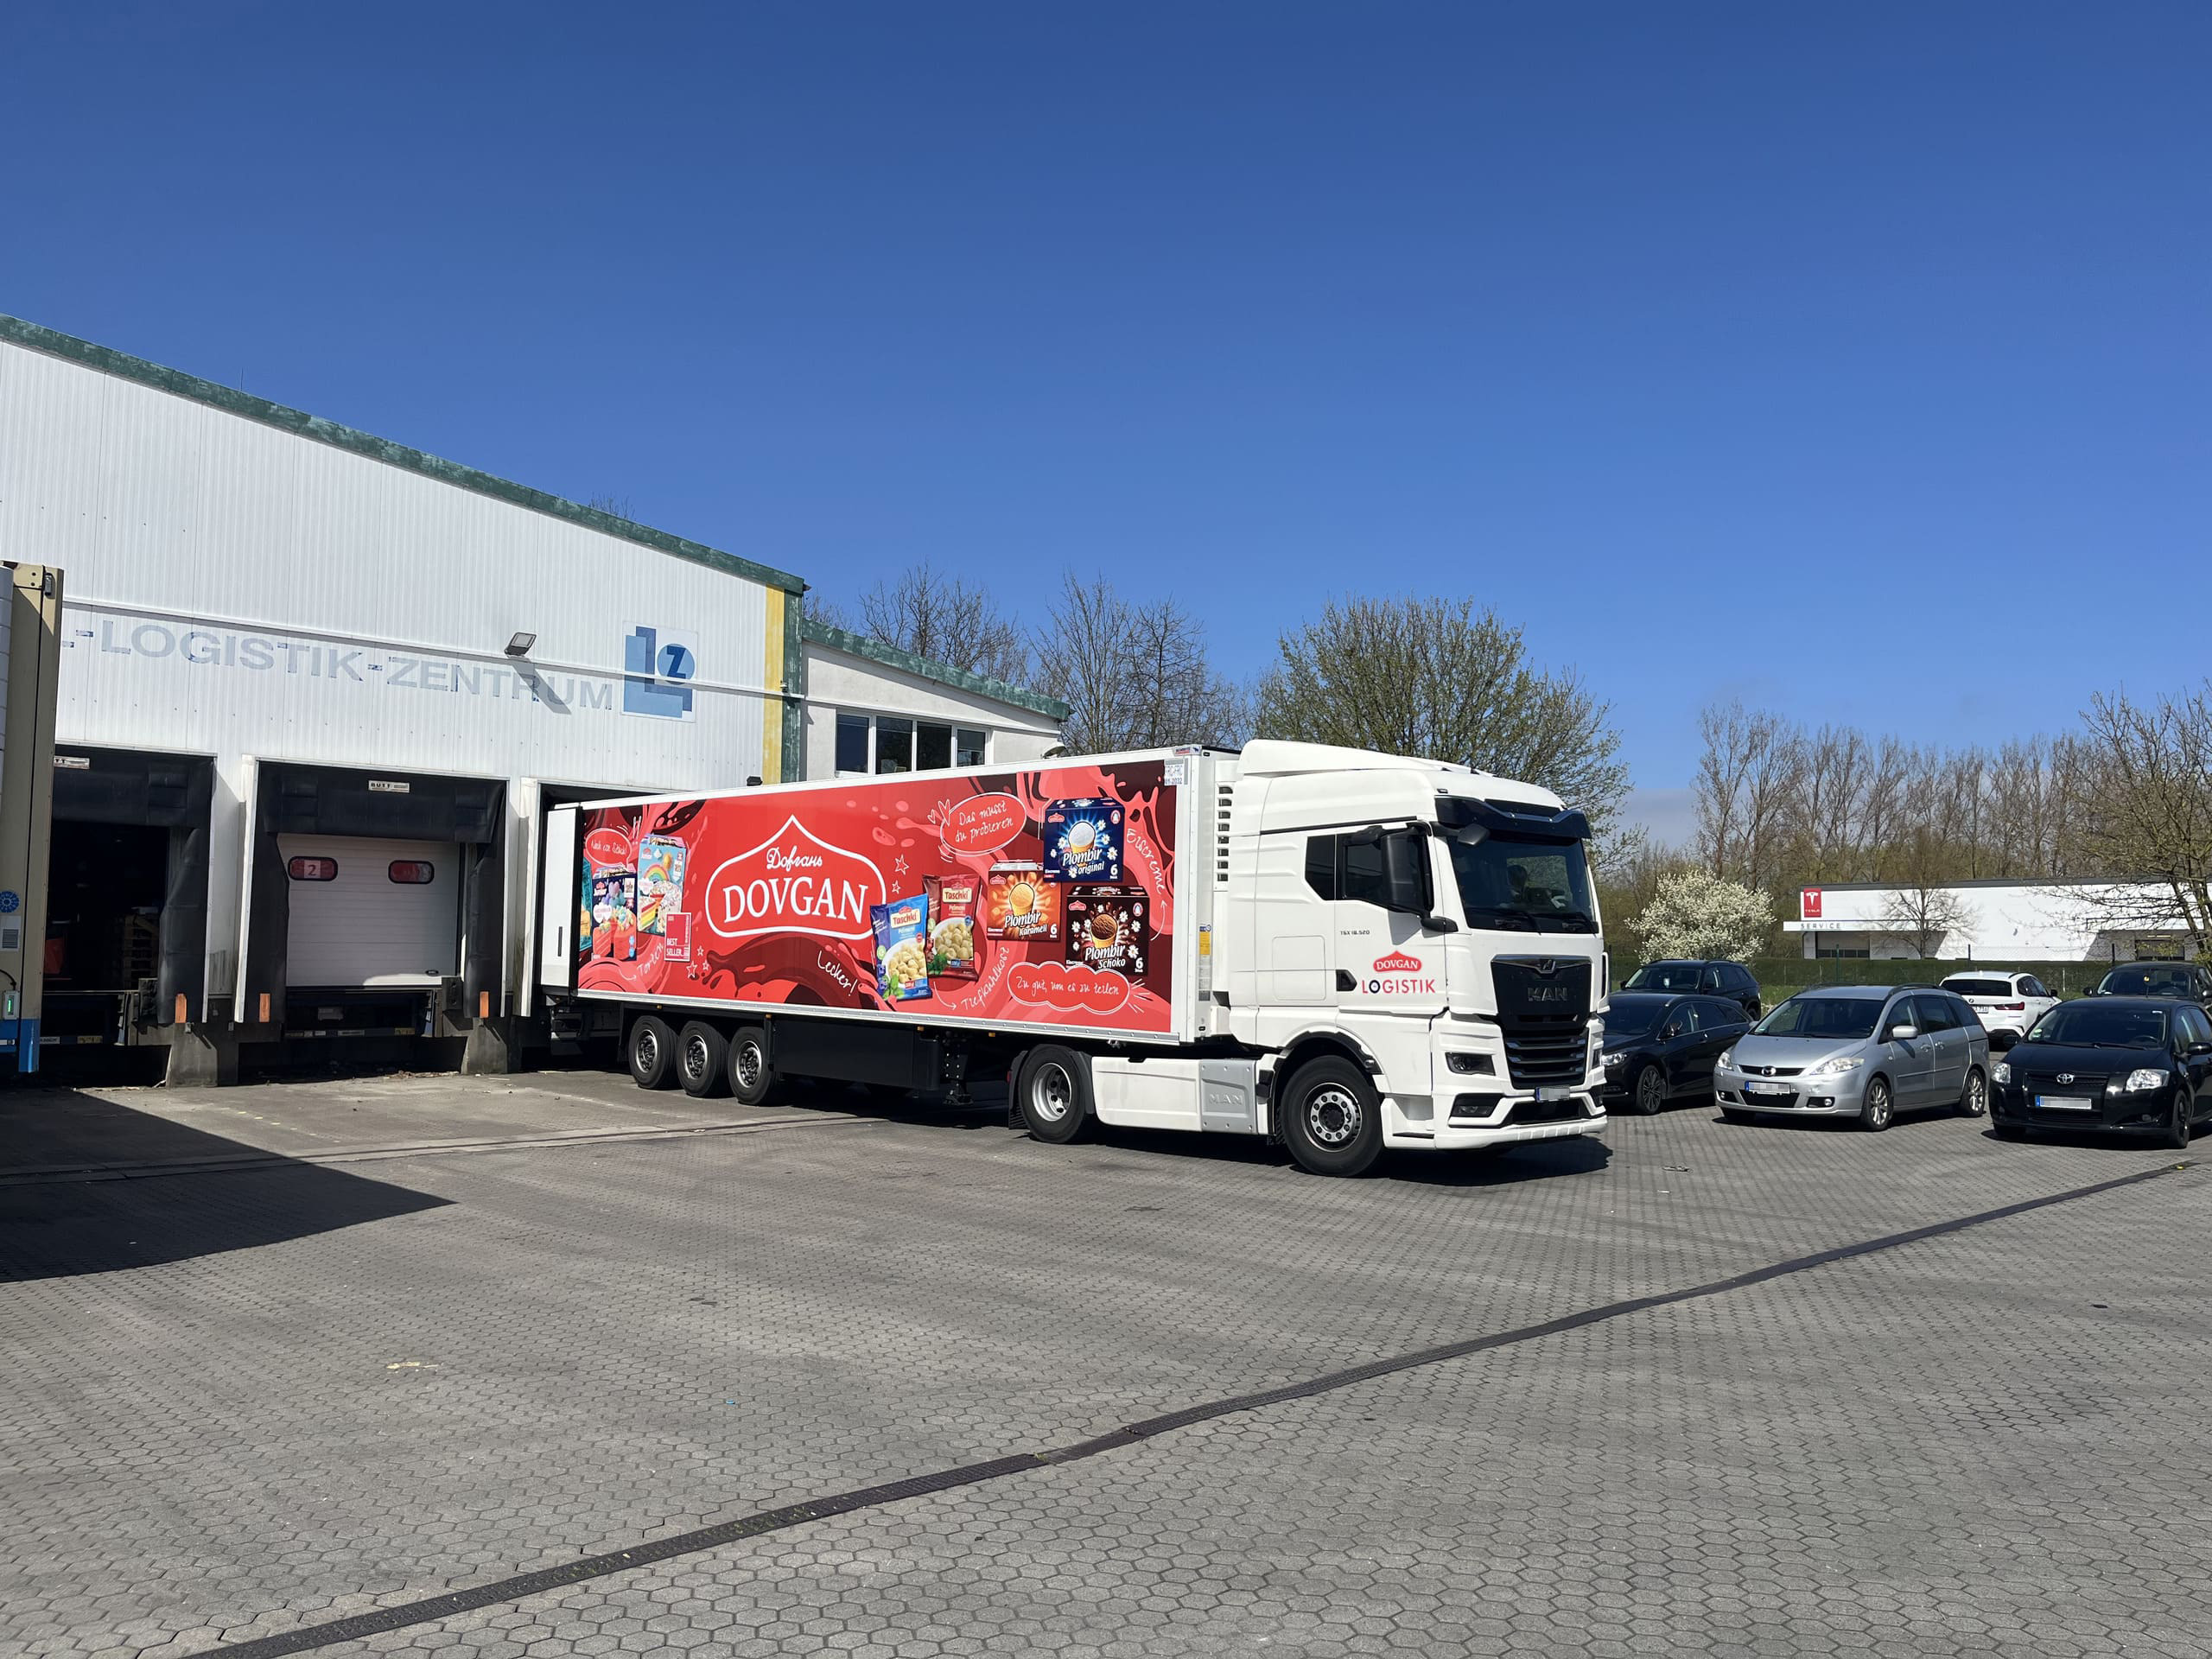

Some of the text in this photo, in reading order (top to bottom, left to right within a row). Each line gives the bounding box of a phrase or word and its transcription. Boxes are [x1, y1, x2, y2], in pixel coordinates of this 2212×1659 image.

[62, 620, 613, 711] -LOGISTIK-ZENTRUM
[959, 800, 1007, 826] Das musst
[955, 817, 1014, 844] du probieren
[1062, 847, 1103, 867] Plombir
[1127, 828, 1166, 895] Eiscreme
[307, 864, 317, 876] 2
[1077, 861, 1105, 875] original
[1110, 864, 1118, 876] 6
[722, 876, 868, 924] DOVGAN
[944, 890, 969, 900] Taschki
[892, 912, 917, 925] Taschki
[1004, 912, 1041, 928] Plombir
[1019, 924, 1047, 937] Karamell
[1050, 923, 1058, 934] 6
[666, 938, 677, 946] BEST
[1084, 944, 1126, 962] Plombir
[1098, 958, 1126, 969] Schoko
[1135, 957, 1143, 969] 6
[1376, 959, 1418, 970] DOVGAN
[817, 950, 858, 996] Lecker!
[1016, 976, 1029, 988] Zu
[1050, 982, 1064, 990] um
[1067, 982, 1076, 992] es
[1079, 984, 1090, 993] zu
[1094, 982, 1119, 995] teilen
[1362, 979, 1435, 994] LOGISTIK
[1528, 987, 1567, 1001] MAN
